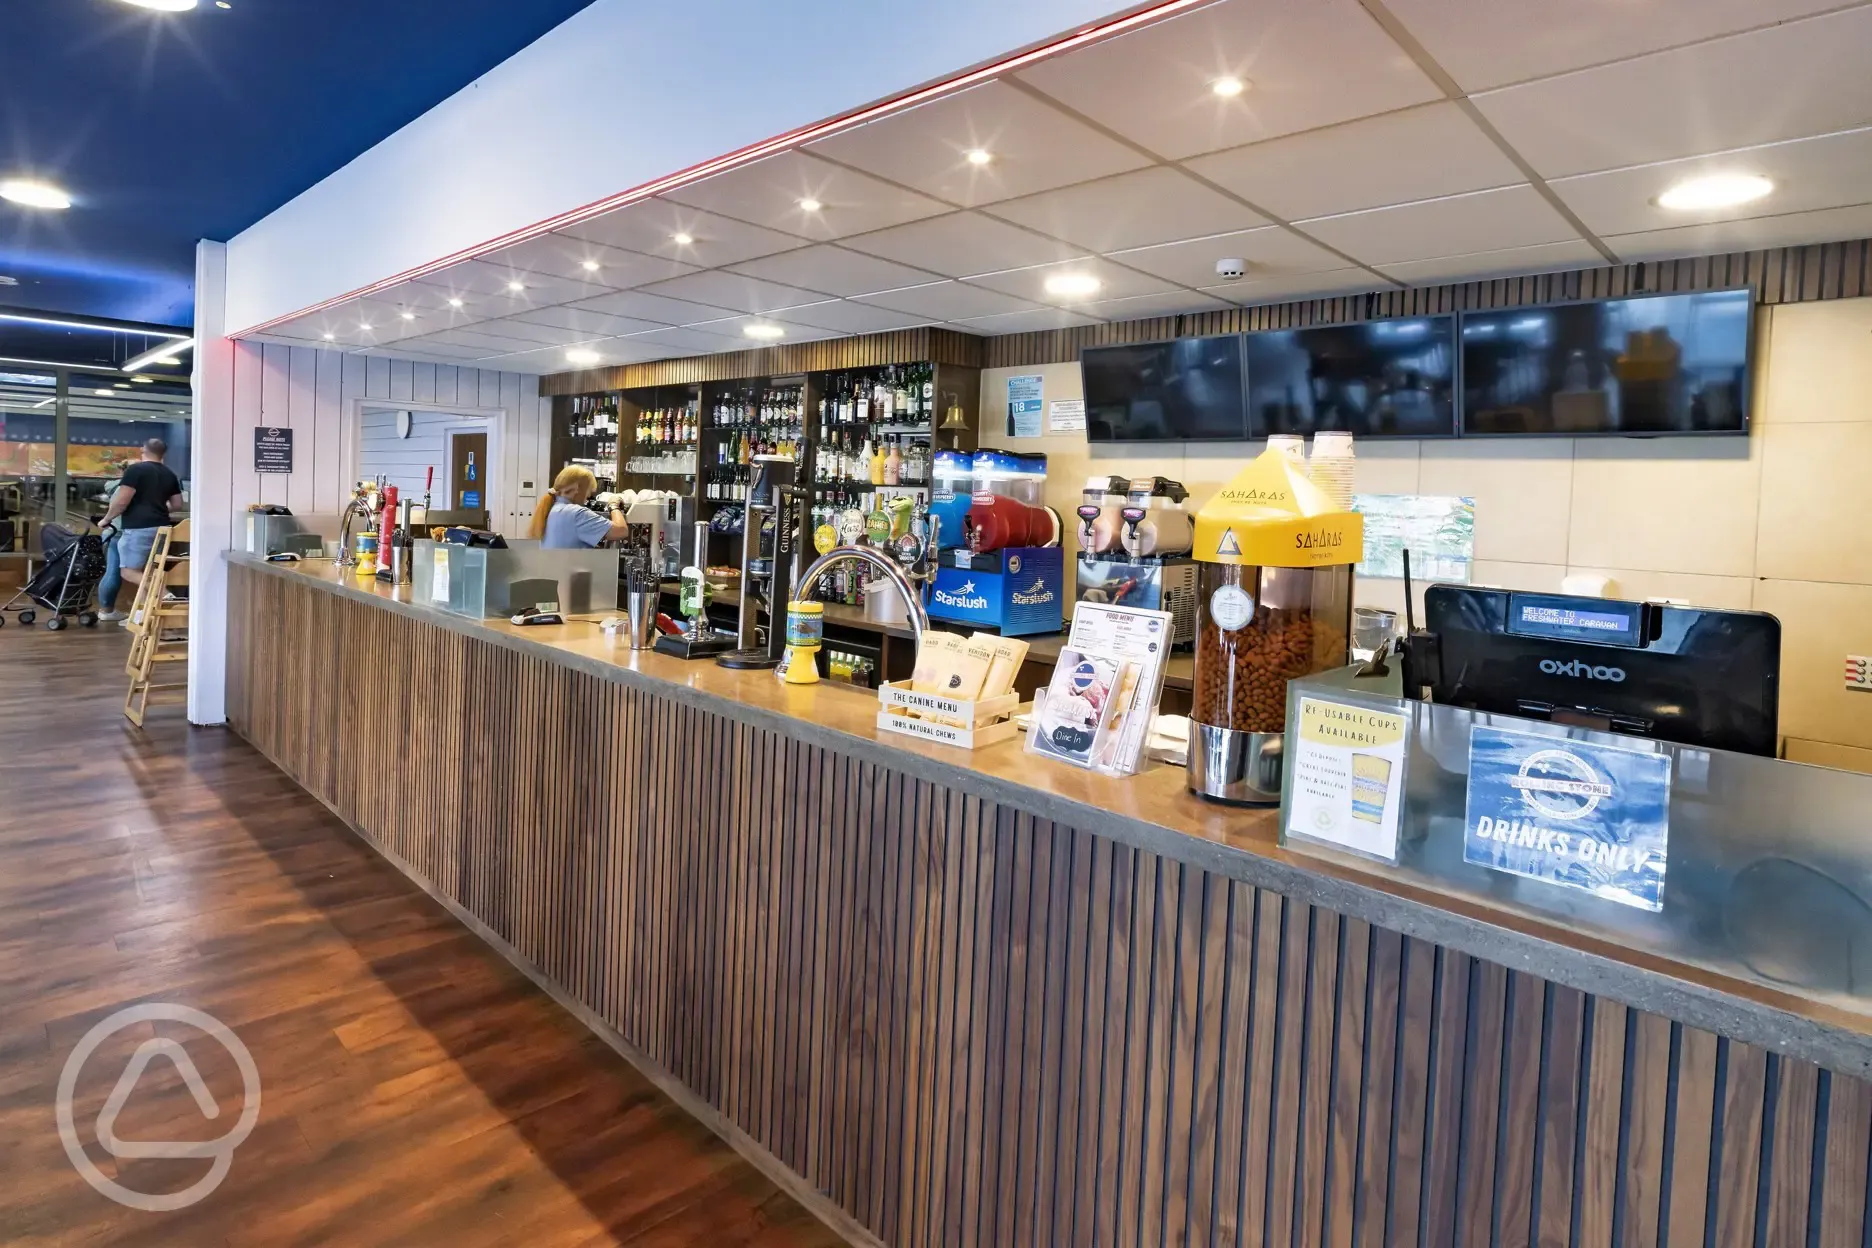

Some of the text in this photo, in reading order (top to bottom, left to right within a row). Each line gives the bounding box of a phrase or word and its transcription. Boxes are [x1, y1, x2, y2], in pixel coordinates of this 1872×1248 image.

[1014, 402, 1025, 412] 18
[1220, 488, 1286, 500] SAHARAS
[780, 507, 791, 553] GUINNESS
[1295, 528, 1343, 549] SAHARAS
[935, 590, 988, 609] Starslush
[1012, 590, 1054, 605] Starslush
[1523, 606, 1576, 618] WELCOME TO
[1523, 613, 1618, 629] FRESHWATER CARAVAN
[968, 647, 991, 659] VENISON
[1539, 659, 1626, 682] oxhoo
[893, 692, 958, 713] THE CANINE MENU
[892, 720, 907, 729] 100%
[908, 723, 934, 735] NATURAL
[935, 729, 956, 740] CHEWS
[1055, 730, 1072, 742] Dine
[1568, 783, 1610, 795] STONE
[1476, 815, 1651, 874] DRINKS ONLY
